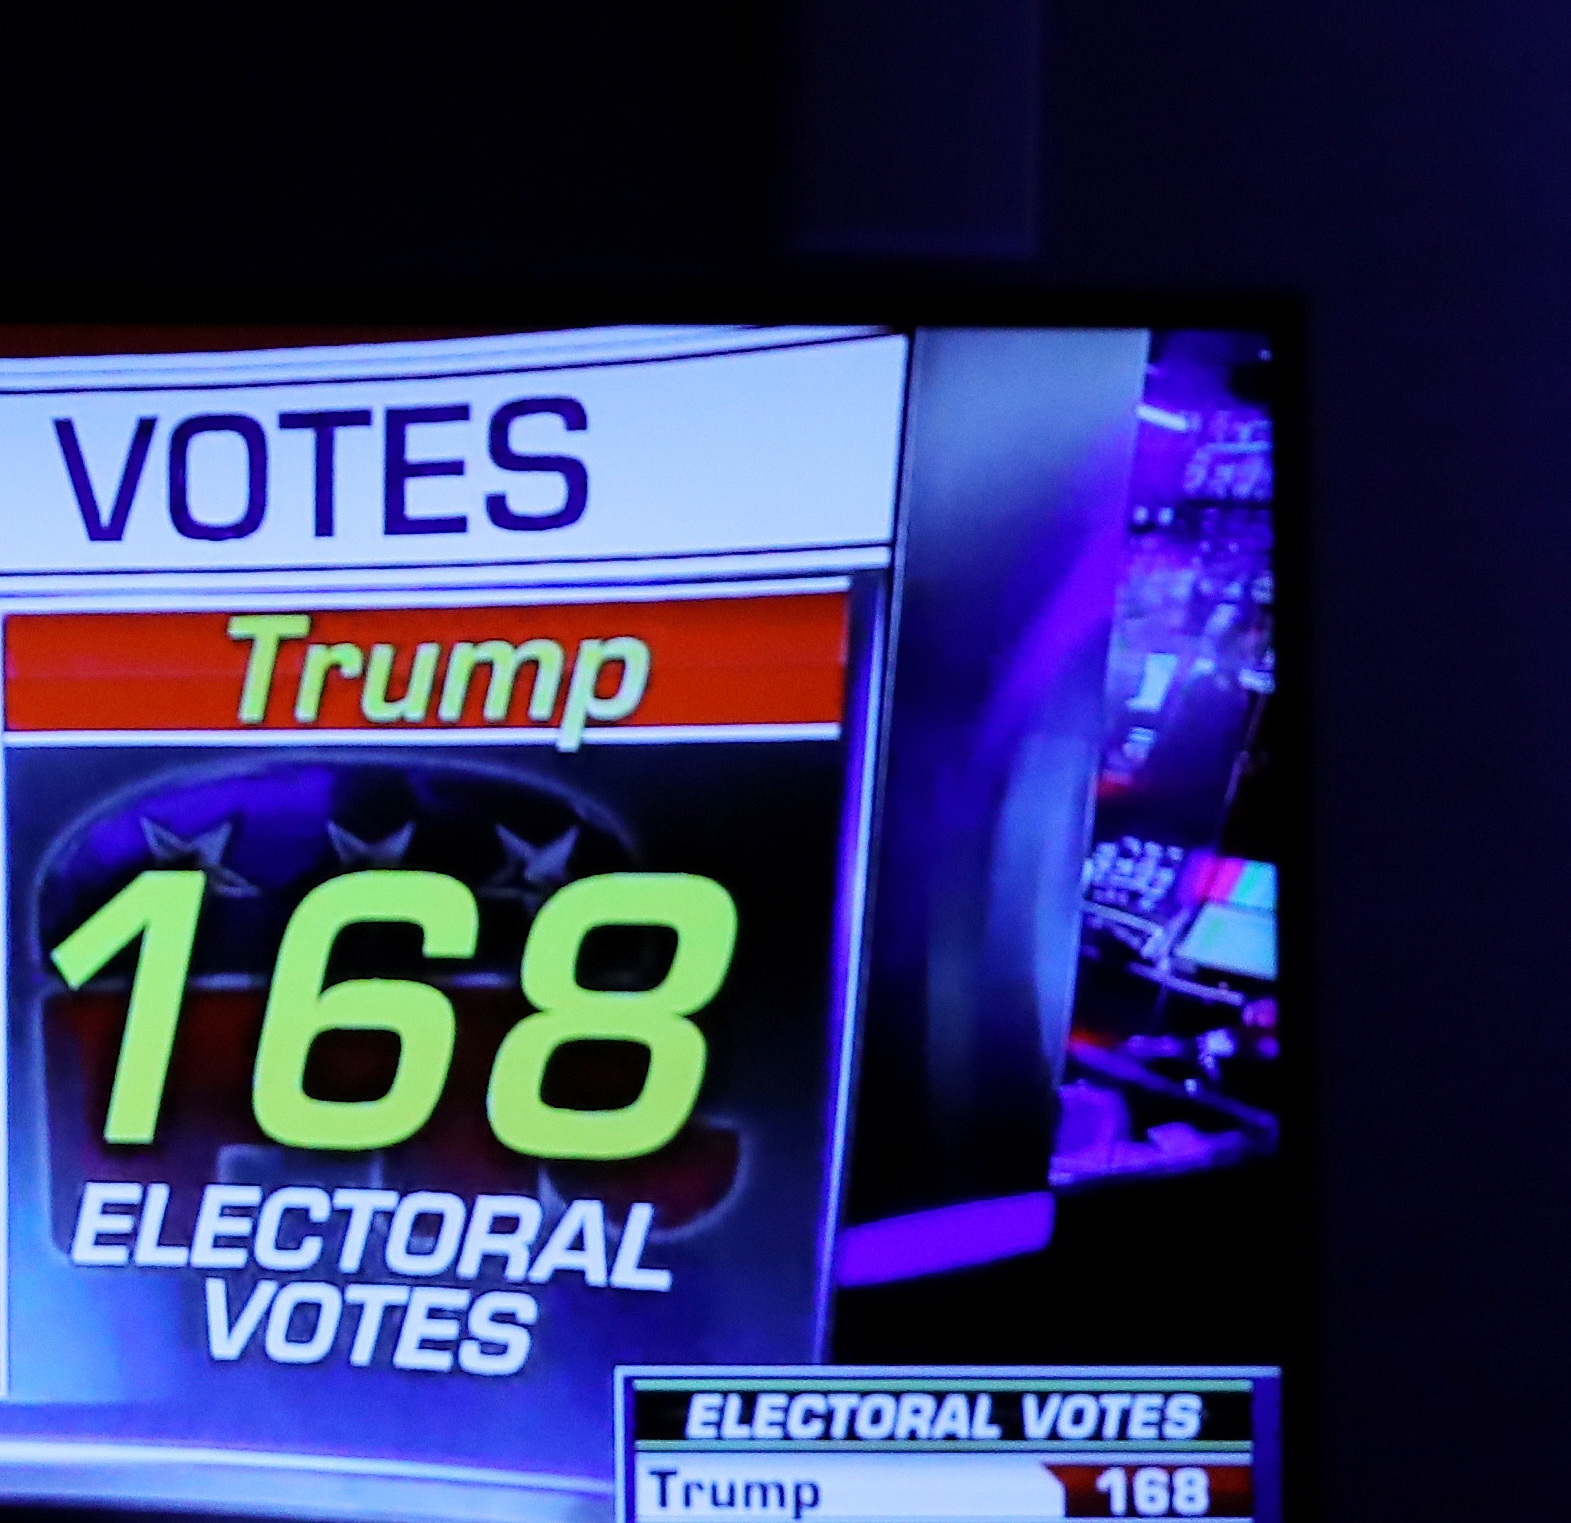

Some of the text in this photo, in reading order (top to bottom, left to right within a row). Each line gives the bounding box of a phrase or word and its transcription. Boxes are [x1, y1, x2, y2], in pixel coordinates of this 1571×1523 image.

[53, 396, 589, 541] VOTES
[227, 614, 651, 752] Trump
[50, 869, 738, 1161] 168
[71, 1181, 672, 1291] ELECTORAL
[204, 1277, 539, 1377] VOTES
[686, 1392, 1203, 1440] ELECTORAL VOTES
[649, 1467, 1211, 1519] Trump 168
